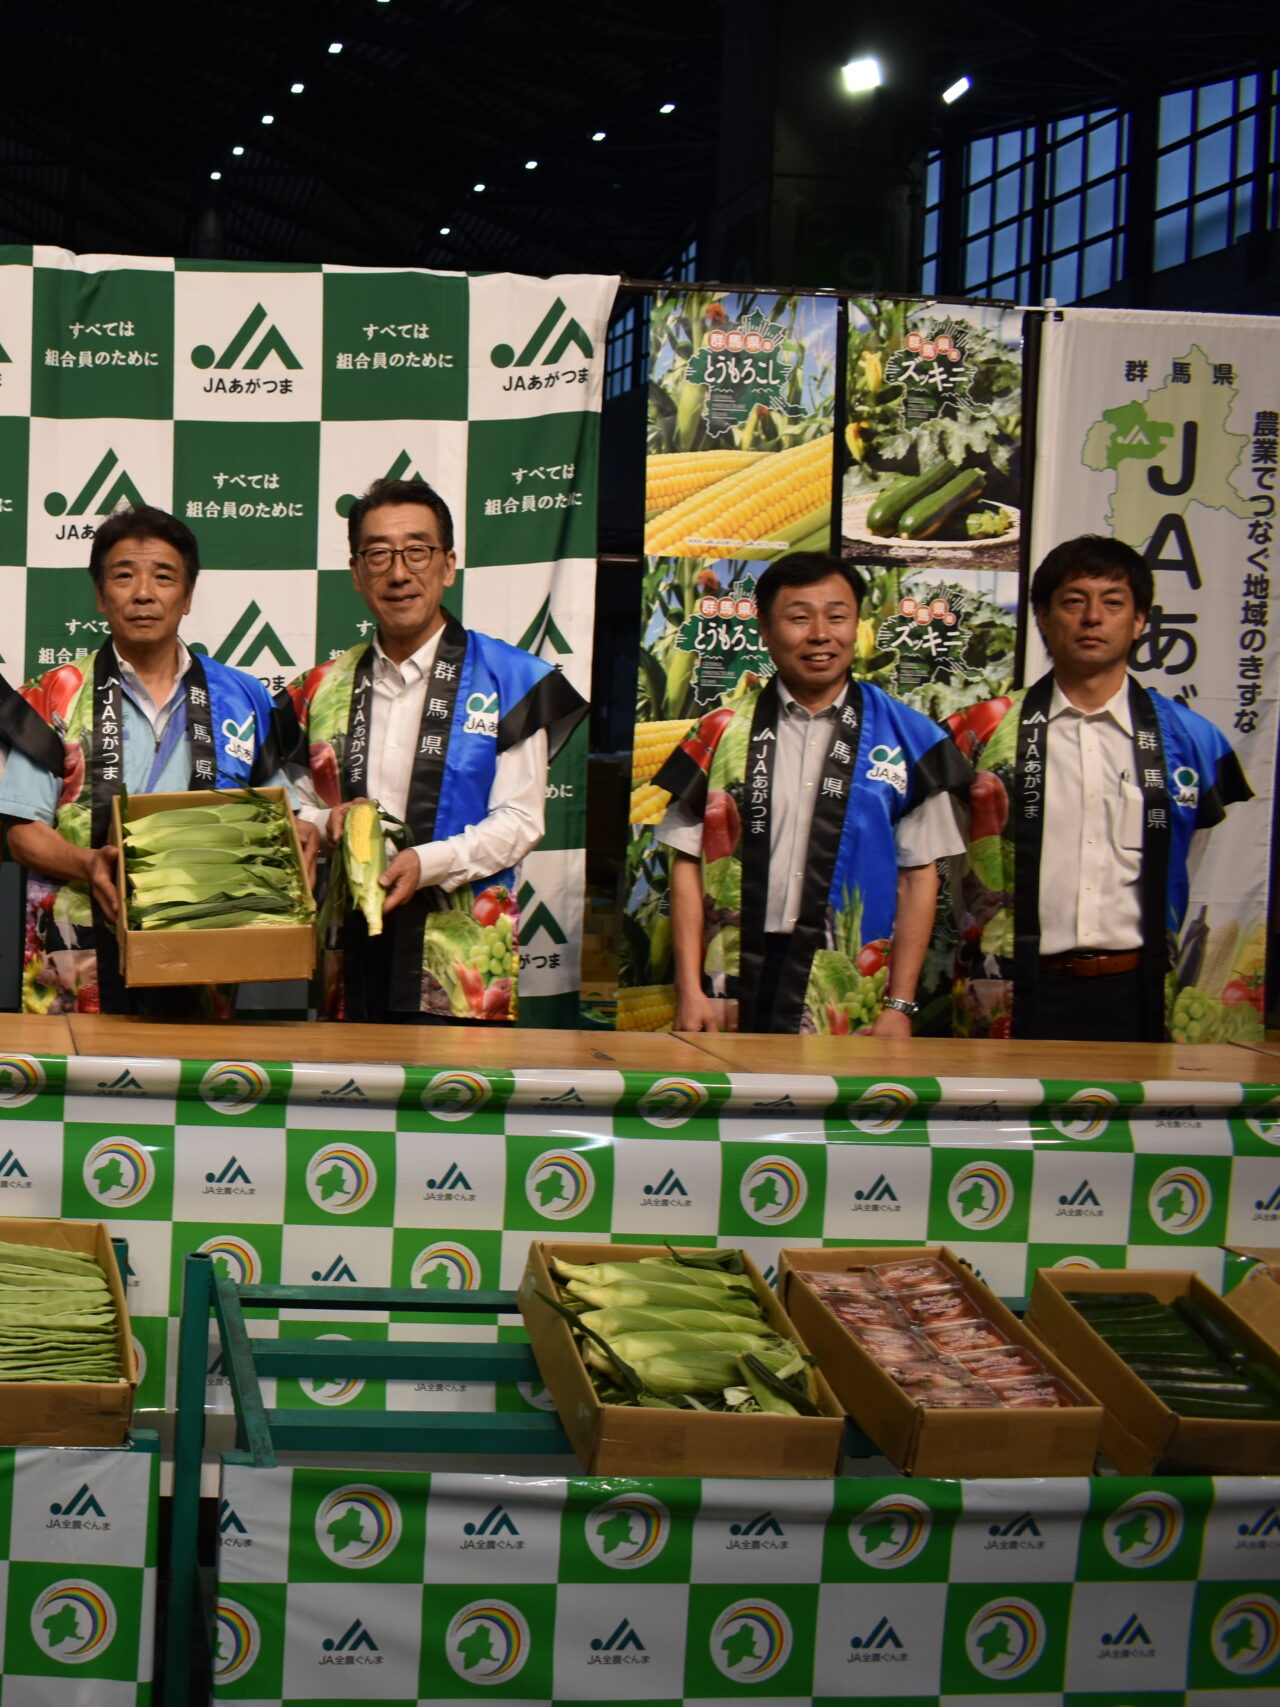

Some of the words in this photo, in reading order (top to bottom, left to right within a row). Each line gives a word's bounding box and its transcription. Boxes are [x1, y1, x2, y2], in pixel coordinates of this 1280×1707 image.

[69, 321, 135, 339] すべては
[362, 323, 430, 340] すべては
[45, 349, 159, 368] 組合員のために
[336, 352, 454, 370] 組合員のために
[703, 356, 782, 385] とうもろこし
[203, 376, 293, 394] JAあがつま
[502, 367, 589, 392] JAあがつま
[898, 358, 969, 392] ズッキーニ
[1125, 360, 1234, 385] 群馬県
[213, 472, 280, 489] すべては
[511, 464, 575, 484] すべては
[186, 501, 304, 519] 組合員のために
[1233, 410, 1280, 734] 農業でつなぐ地域のきずな
[891, 624, 962, 657] ズッキーニ
[38, 647, 98, 665] 組合員
[419, 660, 457, 756] 群馬県
[101, 690, 119, 781] JAあがつま
[349, 692, 367, 783] JAあがつま
[1023, 728, 1042, 819] JAあがつま
[1137, 730, 1167, 829] 群馬県
[751, 744, 769, 834] JAあがつま
[46, 1519, 112, 1532] JA全農ぐんま
